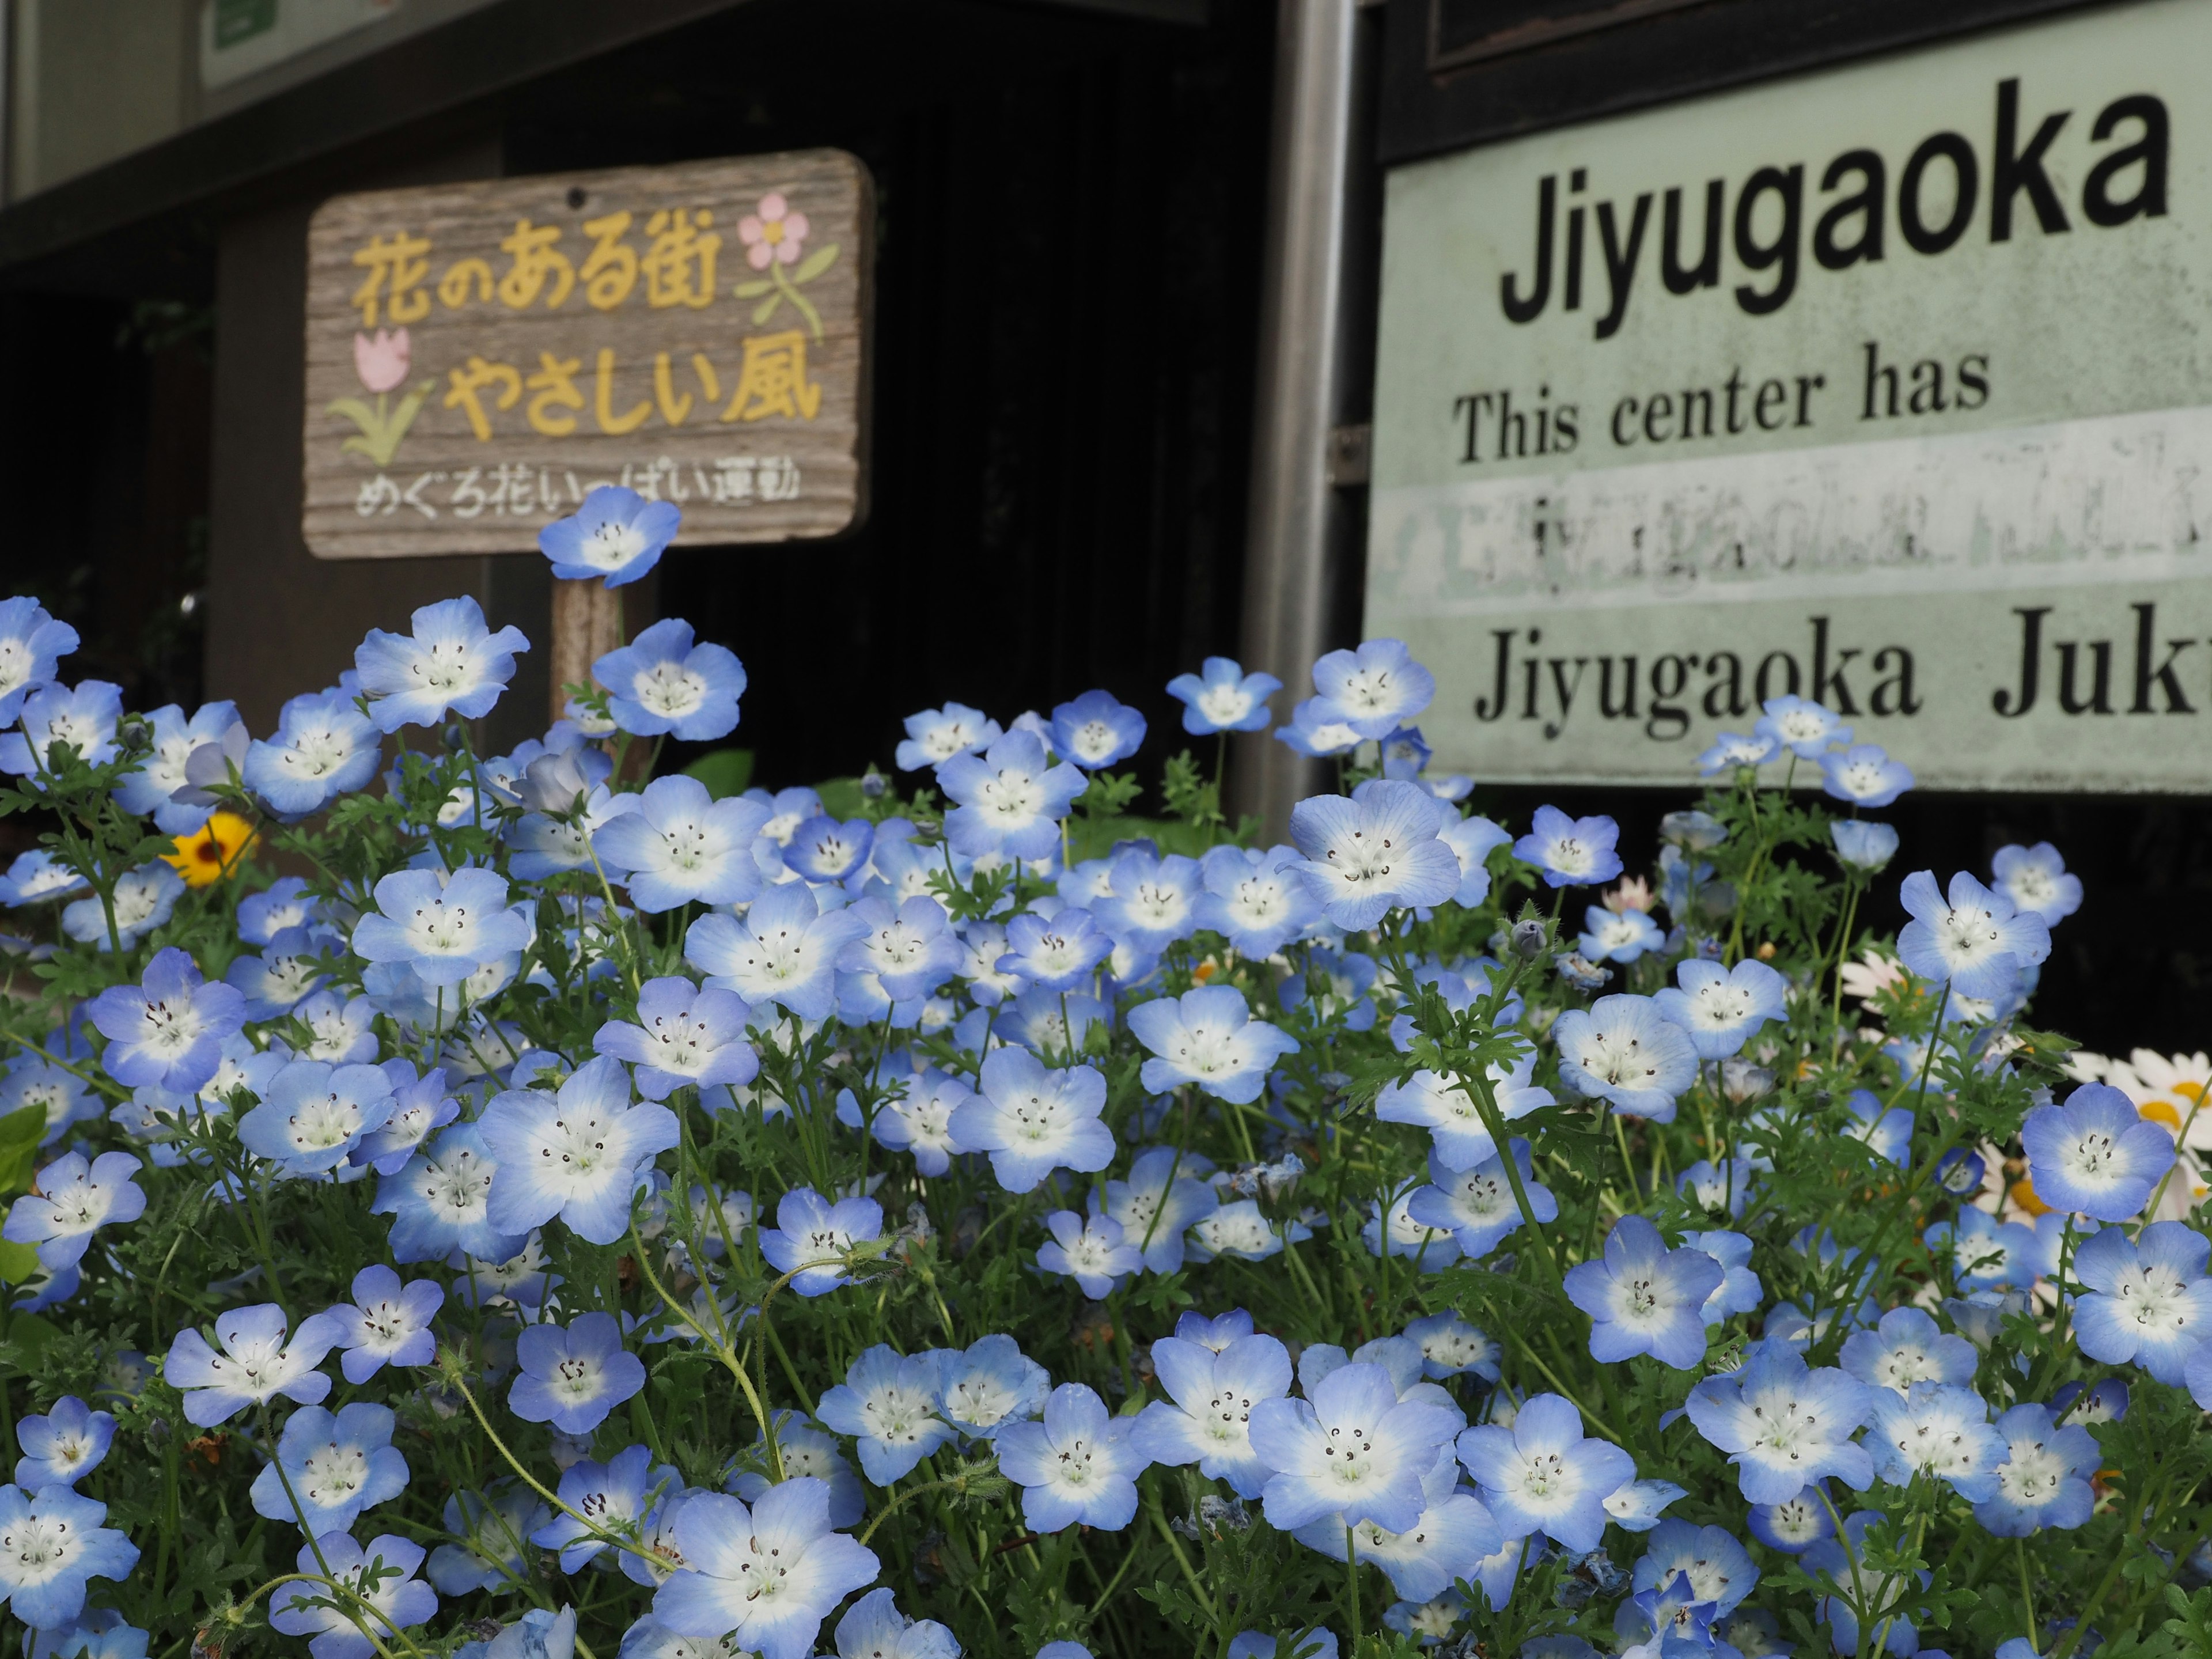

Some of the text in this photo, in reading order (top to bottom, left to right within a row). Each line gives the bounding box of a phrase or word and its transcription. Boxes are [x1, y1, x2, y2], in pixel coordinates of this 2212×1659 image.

[352, 209, 722, 328] 花のある街
[1500, 77, 2171, 341] Jiyugaoka
[445, 331, 821, 441] やさしい風
[1454, 340, 1991, 463] This center has
[1475, 601, 2212, 741] Jiyugaoka Juk
